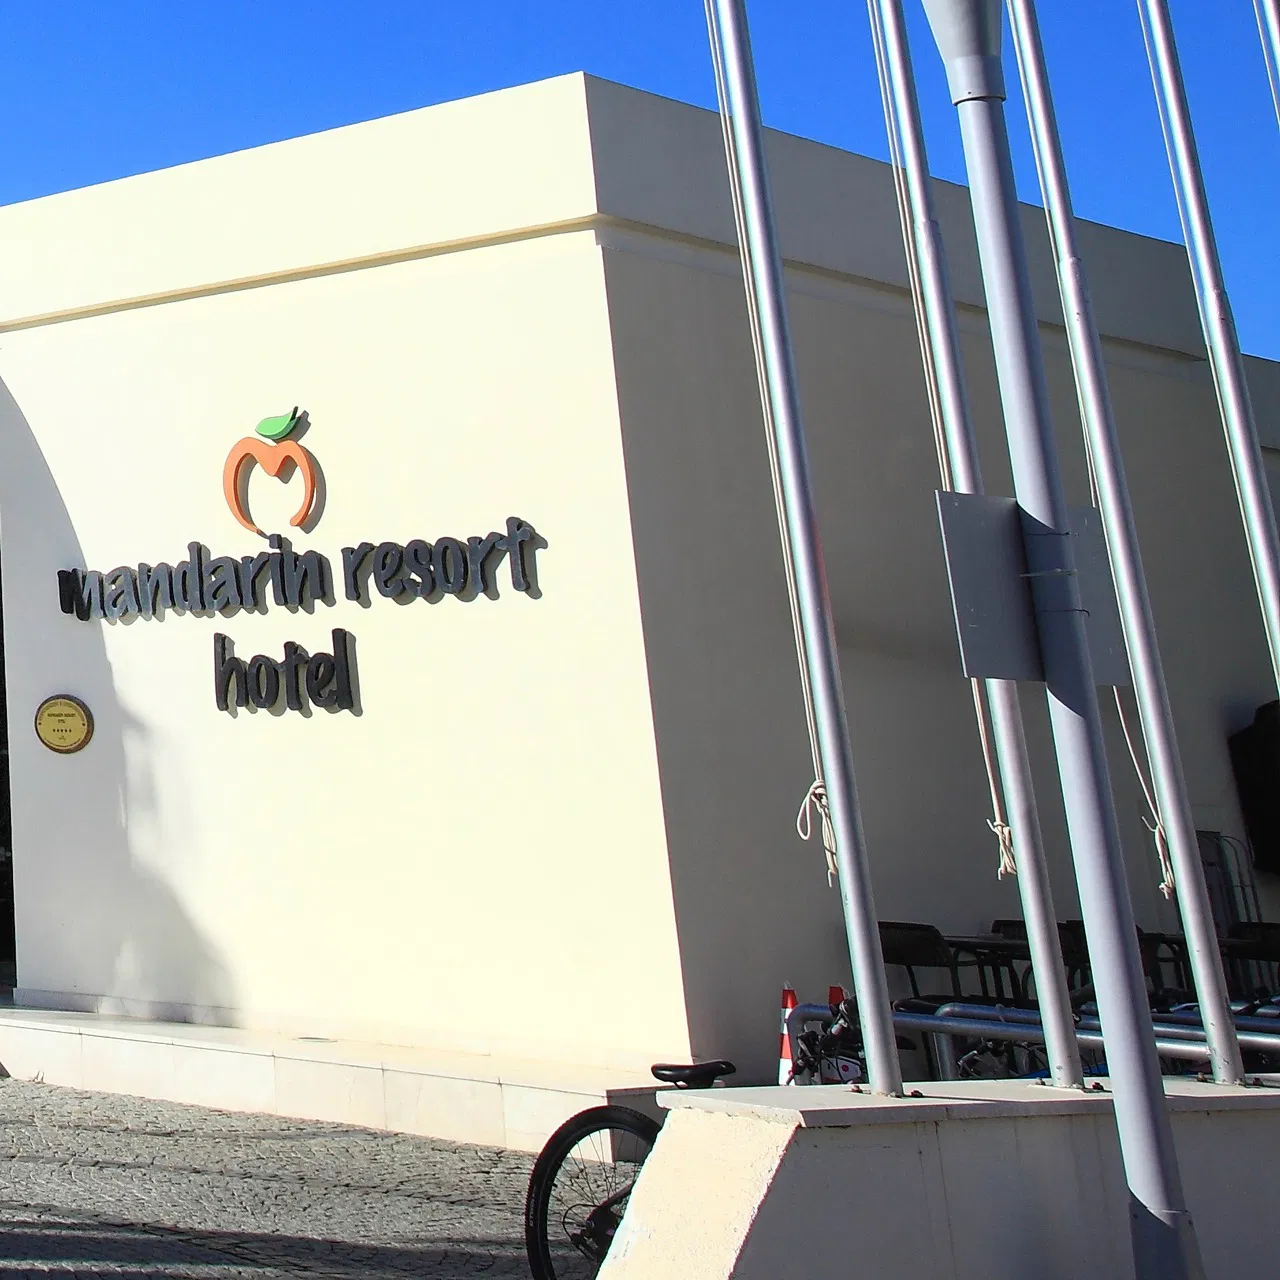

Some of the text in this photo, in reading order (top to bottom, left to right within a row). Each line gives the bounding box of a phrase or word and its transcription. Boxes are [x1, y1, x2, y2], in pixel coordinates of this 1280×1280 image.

[57, 517, 532, 621] mandarin resort
[214, 628, 354, 712] hotel
